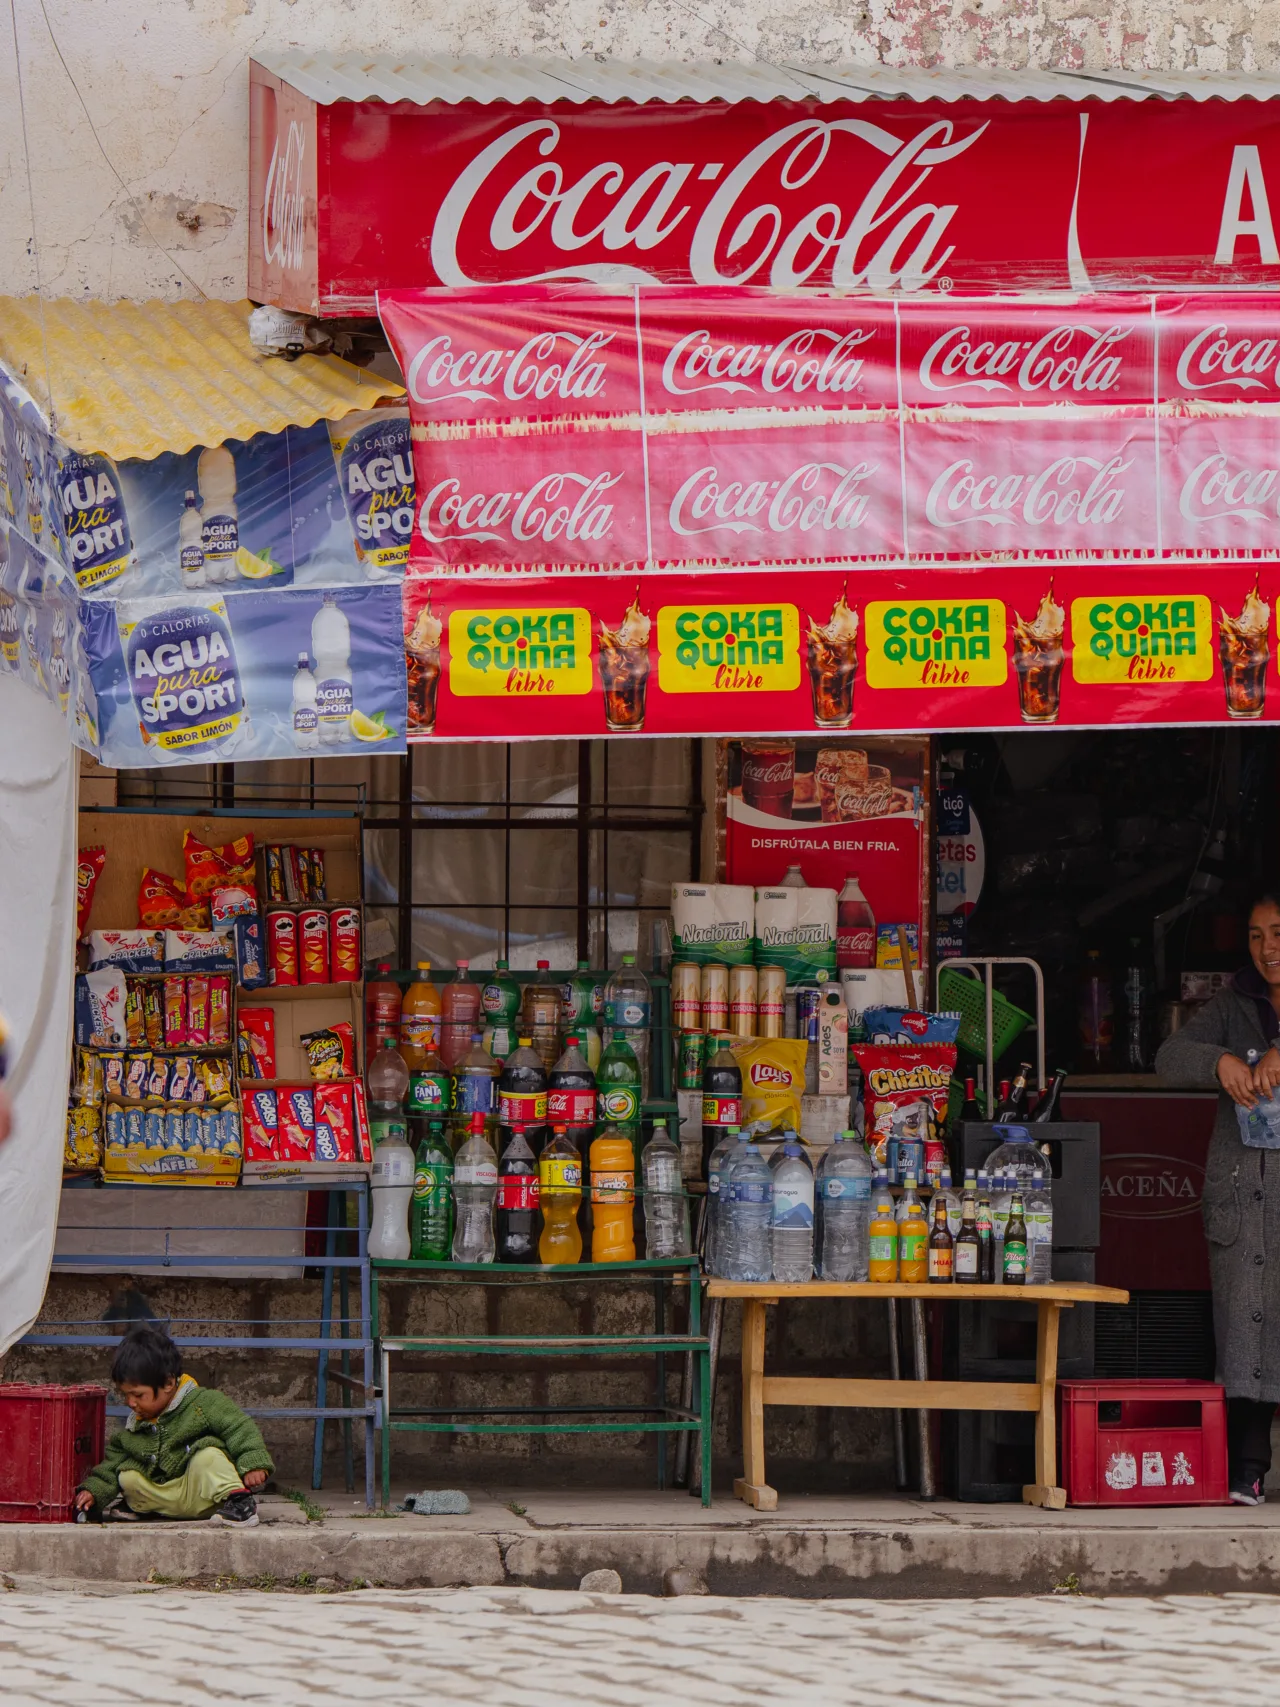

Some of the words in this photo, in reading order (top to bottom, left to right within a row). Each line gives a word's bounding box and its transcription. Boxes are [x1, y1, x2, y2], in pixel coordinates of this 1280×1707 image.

[431, 119, 991, 290] Coca-Cola
[409, 331, 618, 402] Coca-Cola
[662, 329, 877, 395] Coca-Cola
[919, 324, 1135, 393] Coca-Cola
[364, 430, 411, 450] CALORÍ
[348, 451, 414, 494] AGU
[669, 461, 880, 536] Coca-Cola
[926, 454, 1136, 526] Coca-Cola
[368, 485, 416, 526] pur
[419, 471, 624, 544] Coca-Cola
[203, 523, 237, 535] AGUA
[356, 507, 414, 540] SPO
[71, 519, 124, 561] ORT
[203, 540, 238, 551] SPORT
[208, 534, 232, 542] pura
[182, 551, 201, 559] AGUA
[90, 564, 121, 582] LIMÓN
[140, 628, 147, 638] 0
[152, 613, 210, 637] CALORÍAS
[467, 613, 575, 643] COKA
[676, 609, 784, 640] COKA
[884, 605, 990, 636] COKA
[1090, 601, 1196, 632] COKA
[134, 631, 229, 679] AGUA
[502, 667, 555, 693] libre
[711, 664, 763, 690] libre
[918, 660, 970, 686] libre
[1124, 656, 1176, 681] libre
[153, 665, 223, 701] pura
[317, 688, 351, 699] AGUA
[140, 677, 236, 723] SPORT
[317, 704, 352, 714] SPORT
[323, 697, 346, 705] pura
[165, 731, 198, 746] SABOR
[201, 721, 233, 738] LIMÓN
[296, 720, 316, 728] SPORT
[742, 760, 793, 783] Coca-Cola
[837, 788, 892, 815] Coca-Cola
[751, 837, 830, 850] DISFRÚTALA
[833, 840, 863, 851] BIEN
[867, 841, 899, 851] FRIA.
[115, 938, 146, 951] Soda
[188, 938, 220, 951] Soda
[304, 930, 323, 938] PRINGLES
[337, 928, 355, 936] PRINGLES
[681, 921, 748, 945] Nacional
[762, 923, 830, 947] Nacional
[837, 932, 875, 950] ca-Cola
[109, 947, 157, 961] CRACKERS
[182, 946, 230, 961] CRACKERS
[89, 992, 104, 1037] CRACKERS
[822, 1025, 831, 1056] AdeS
[754, 1064, 791, 1083] Lay's
[871, 1067, 950, 1095] Chizitos
[415, 1084, 442, 1098] FANTA
[256, 1093, 277, 1126] CRASH
[293, 1093, 314, 1127] CRASH
[316, 1126, 335, 1159] CRASH
[140, 1157, 199, 1176] WAFER
[1101, 1170, 1198, 1198] ACEÑA
[1005, 1252, 1025, 1261] Pilsen
